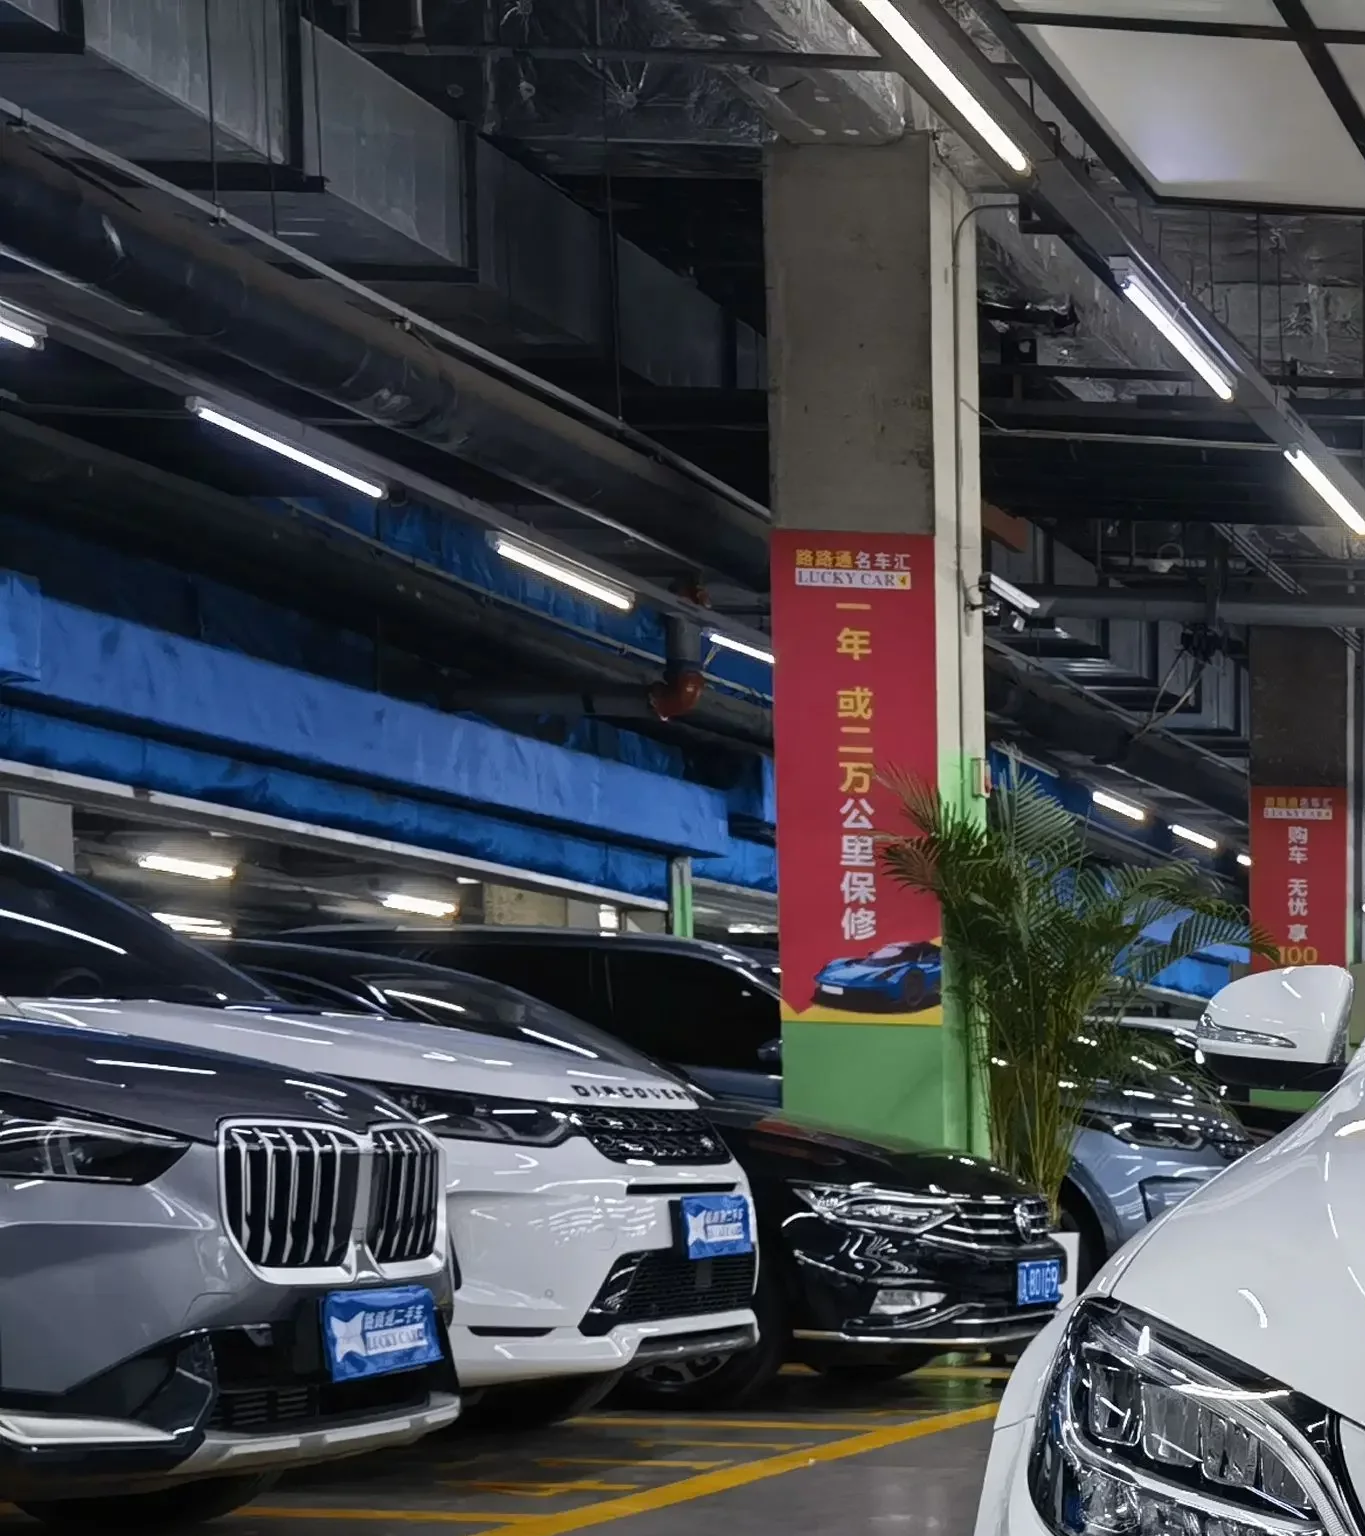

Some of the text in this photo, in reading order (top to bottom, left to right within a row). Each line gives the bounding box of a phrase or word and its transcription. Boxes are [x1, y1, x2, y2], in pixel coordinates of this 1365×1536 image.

[796, 549, 911, 570] 路路通名车汇
[798, 571, 895, 586] LUCKY CAR
